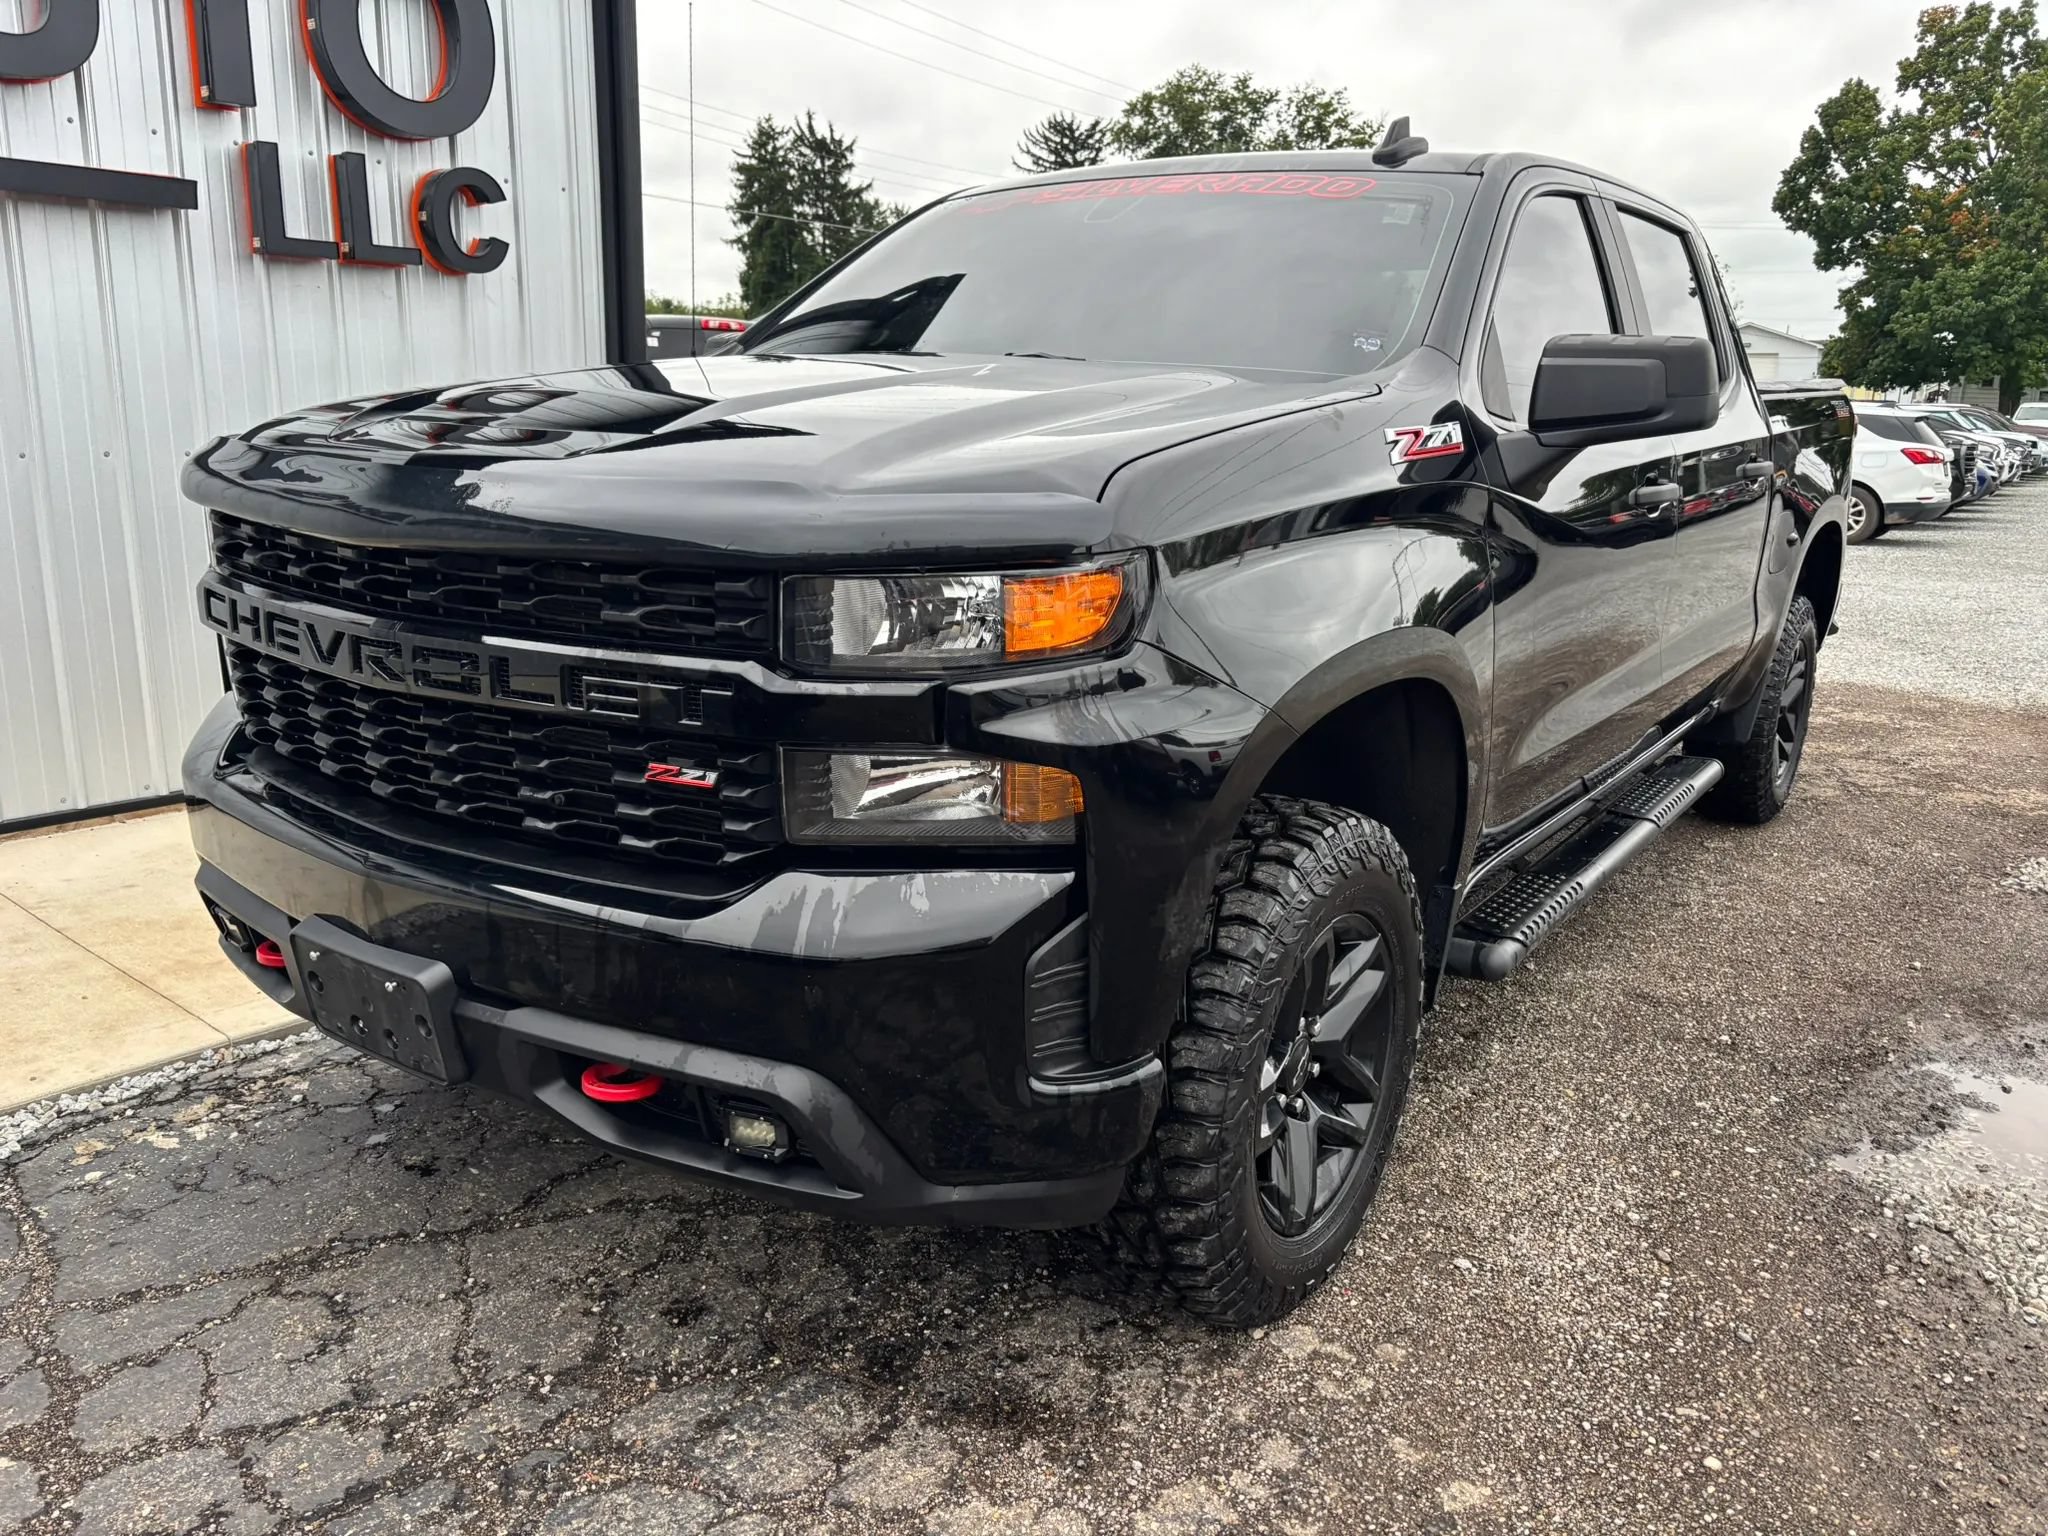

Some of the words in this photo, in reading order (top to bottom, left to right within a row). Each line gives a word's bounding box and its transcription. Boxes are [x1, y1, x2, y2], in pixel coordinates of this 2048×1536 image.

[242, 141, 510, 275] LLC
[1383, 421, 1464, 466] Z71
[203, 585, 734, 727] CHEVROLET
[644, 762, 719, 789] Z71
